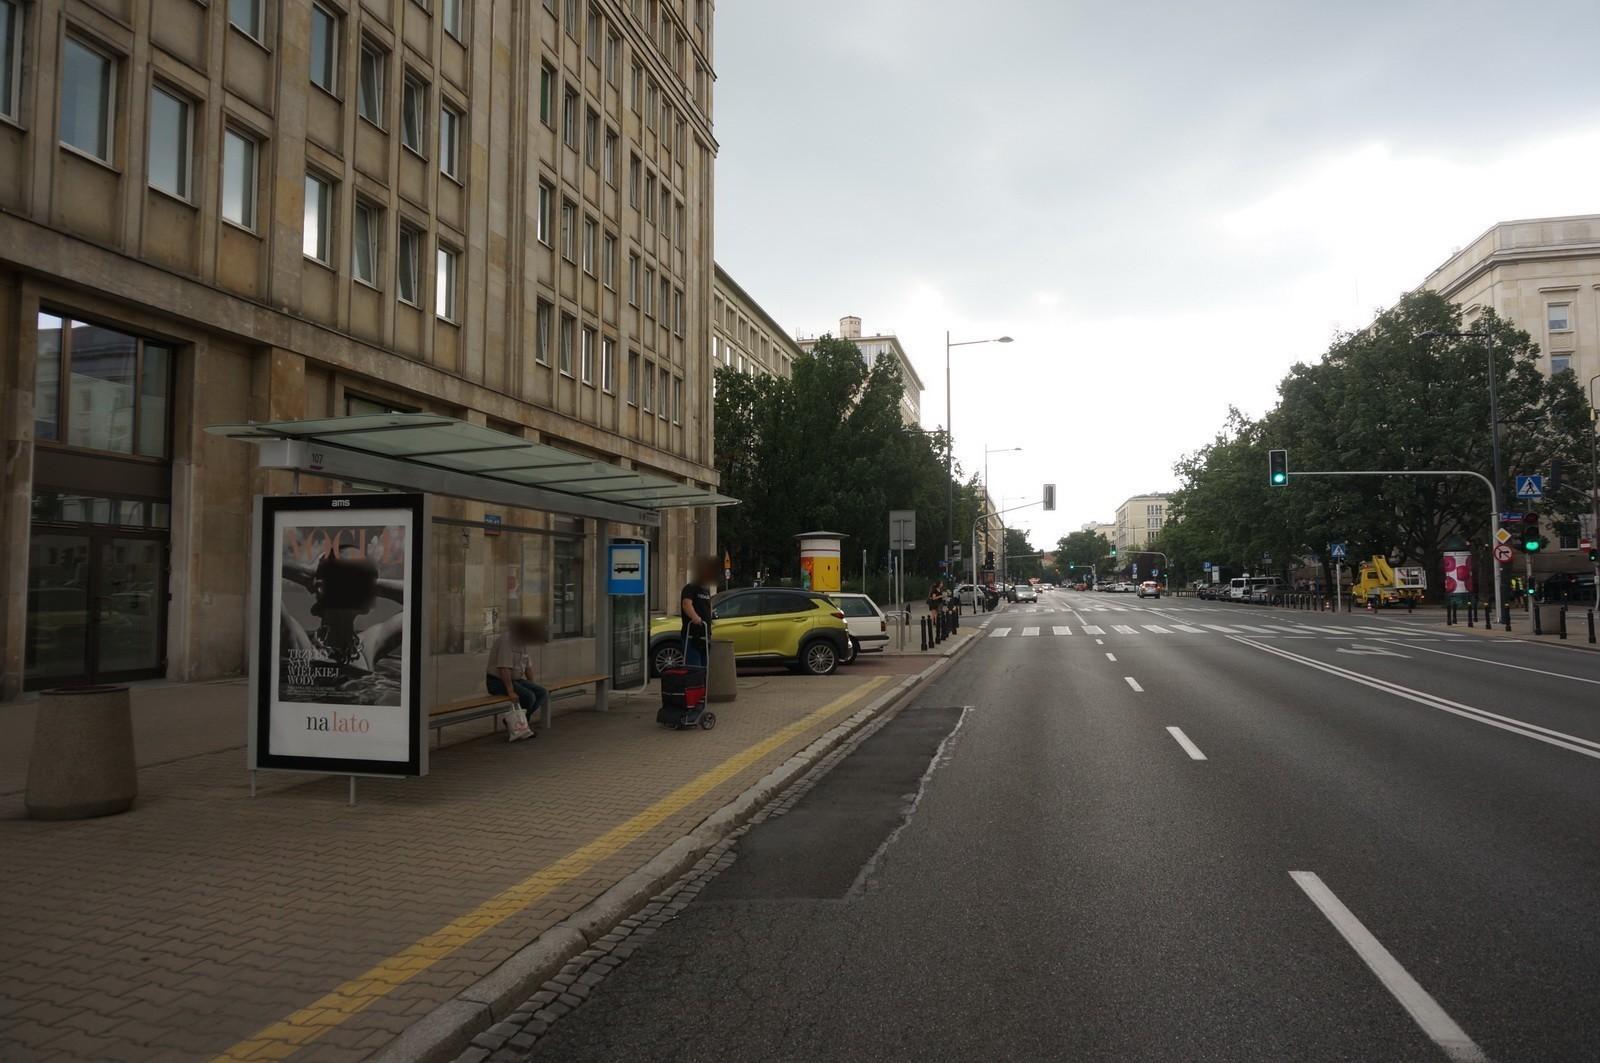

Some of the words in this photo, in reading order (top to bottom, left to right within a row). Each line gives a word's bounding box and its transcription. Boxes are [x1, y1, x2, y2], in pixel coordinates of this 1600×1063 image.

[311, 452, 324, 465] 107
[331, 498, 351, 507] ams
[287, 664, 340, 678] WIELKIEJ
[287, 674, 316, 686] WODY
